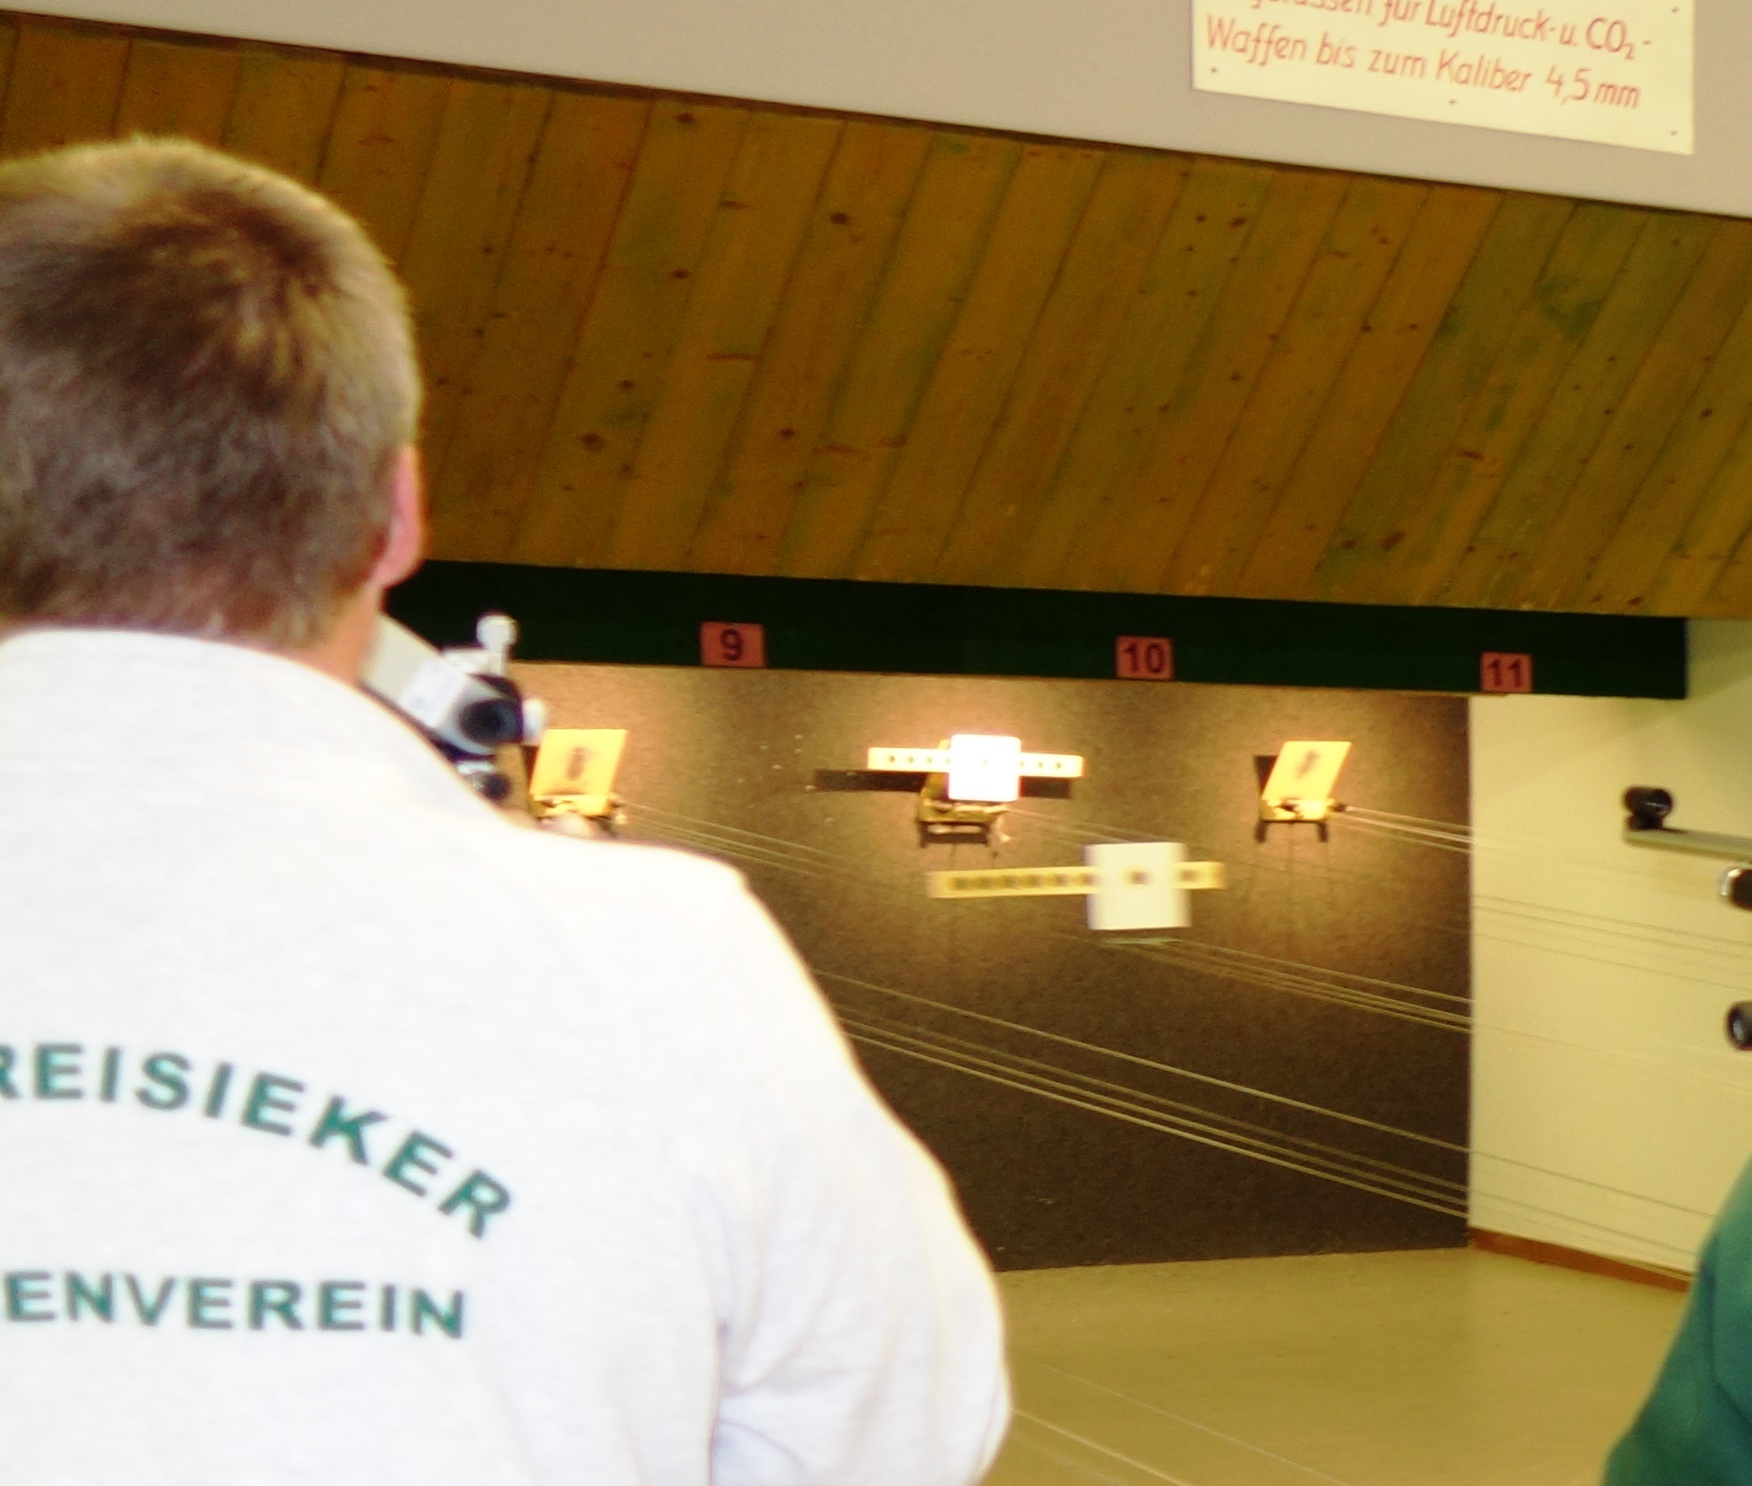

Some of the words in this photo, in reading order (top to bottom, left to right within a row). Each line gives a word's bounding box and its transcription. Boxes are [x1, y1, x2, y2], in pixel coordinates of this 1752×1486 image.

[1206, 13, 1308, 67] Waffen
[1316, 31, 1358, 69] bis
[1368, 48, 1426, 79] zum
[1436, 49, 1533, 93] Kaliber
[720, 628, 743, 661] 9
[1124, 641, 1165, 674] 10
[1487, 659, 1523, 688] 11
